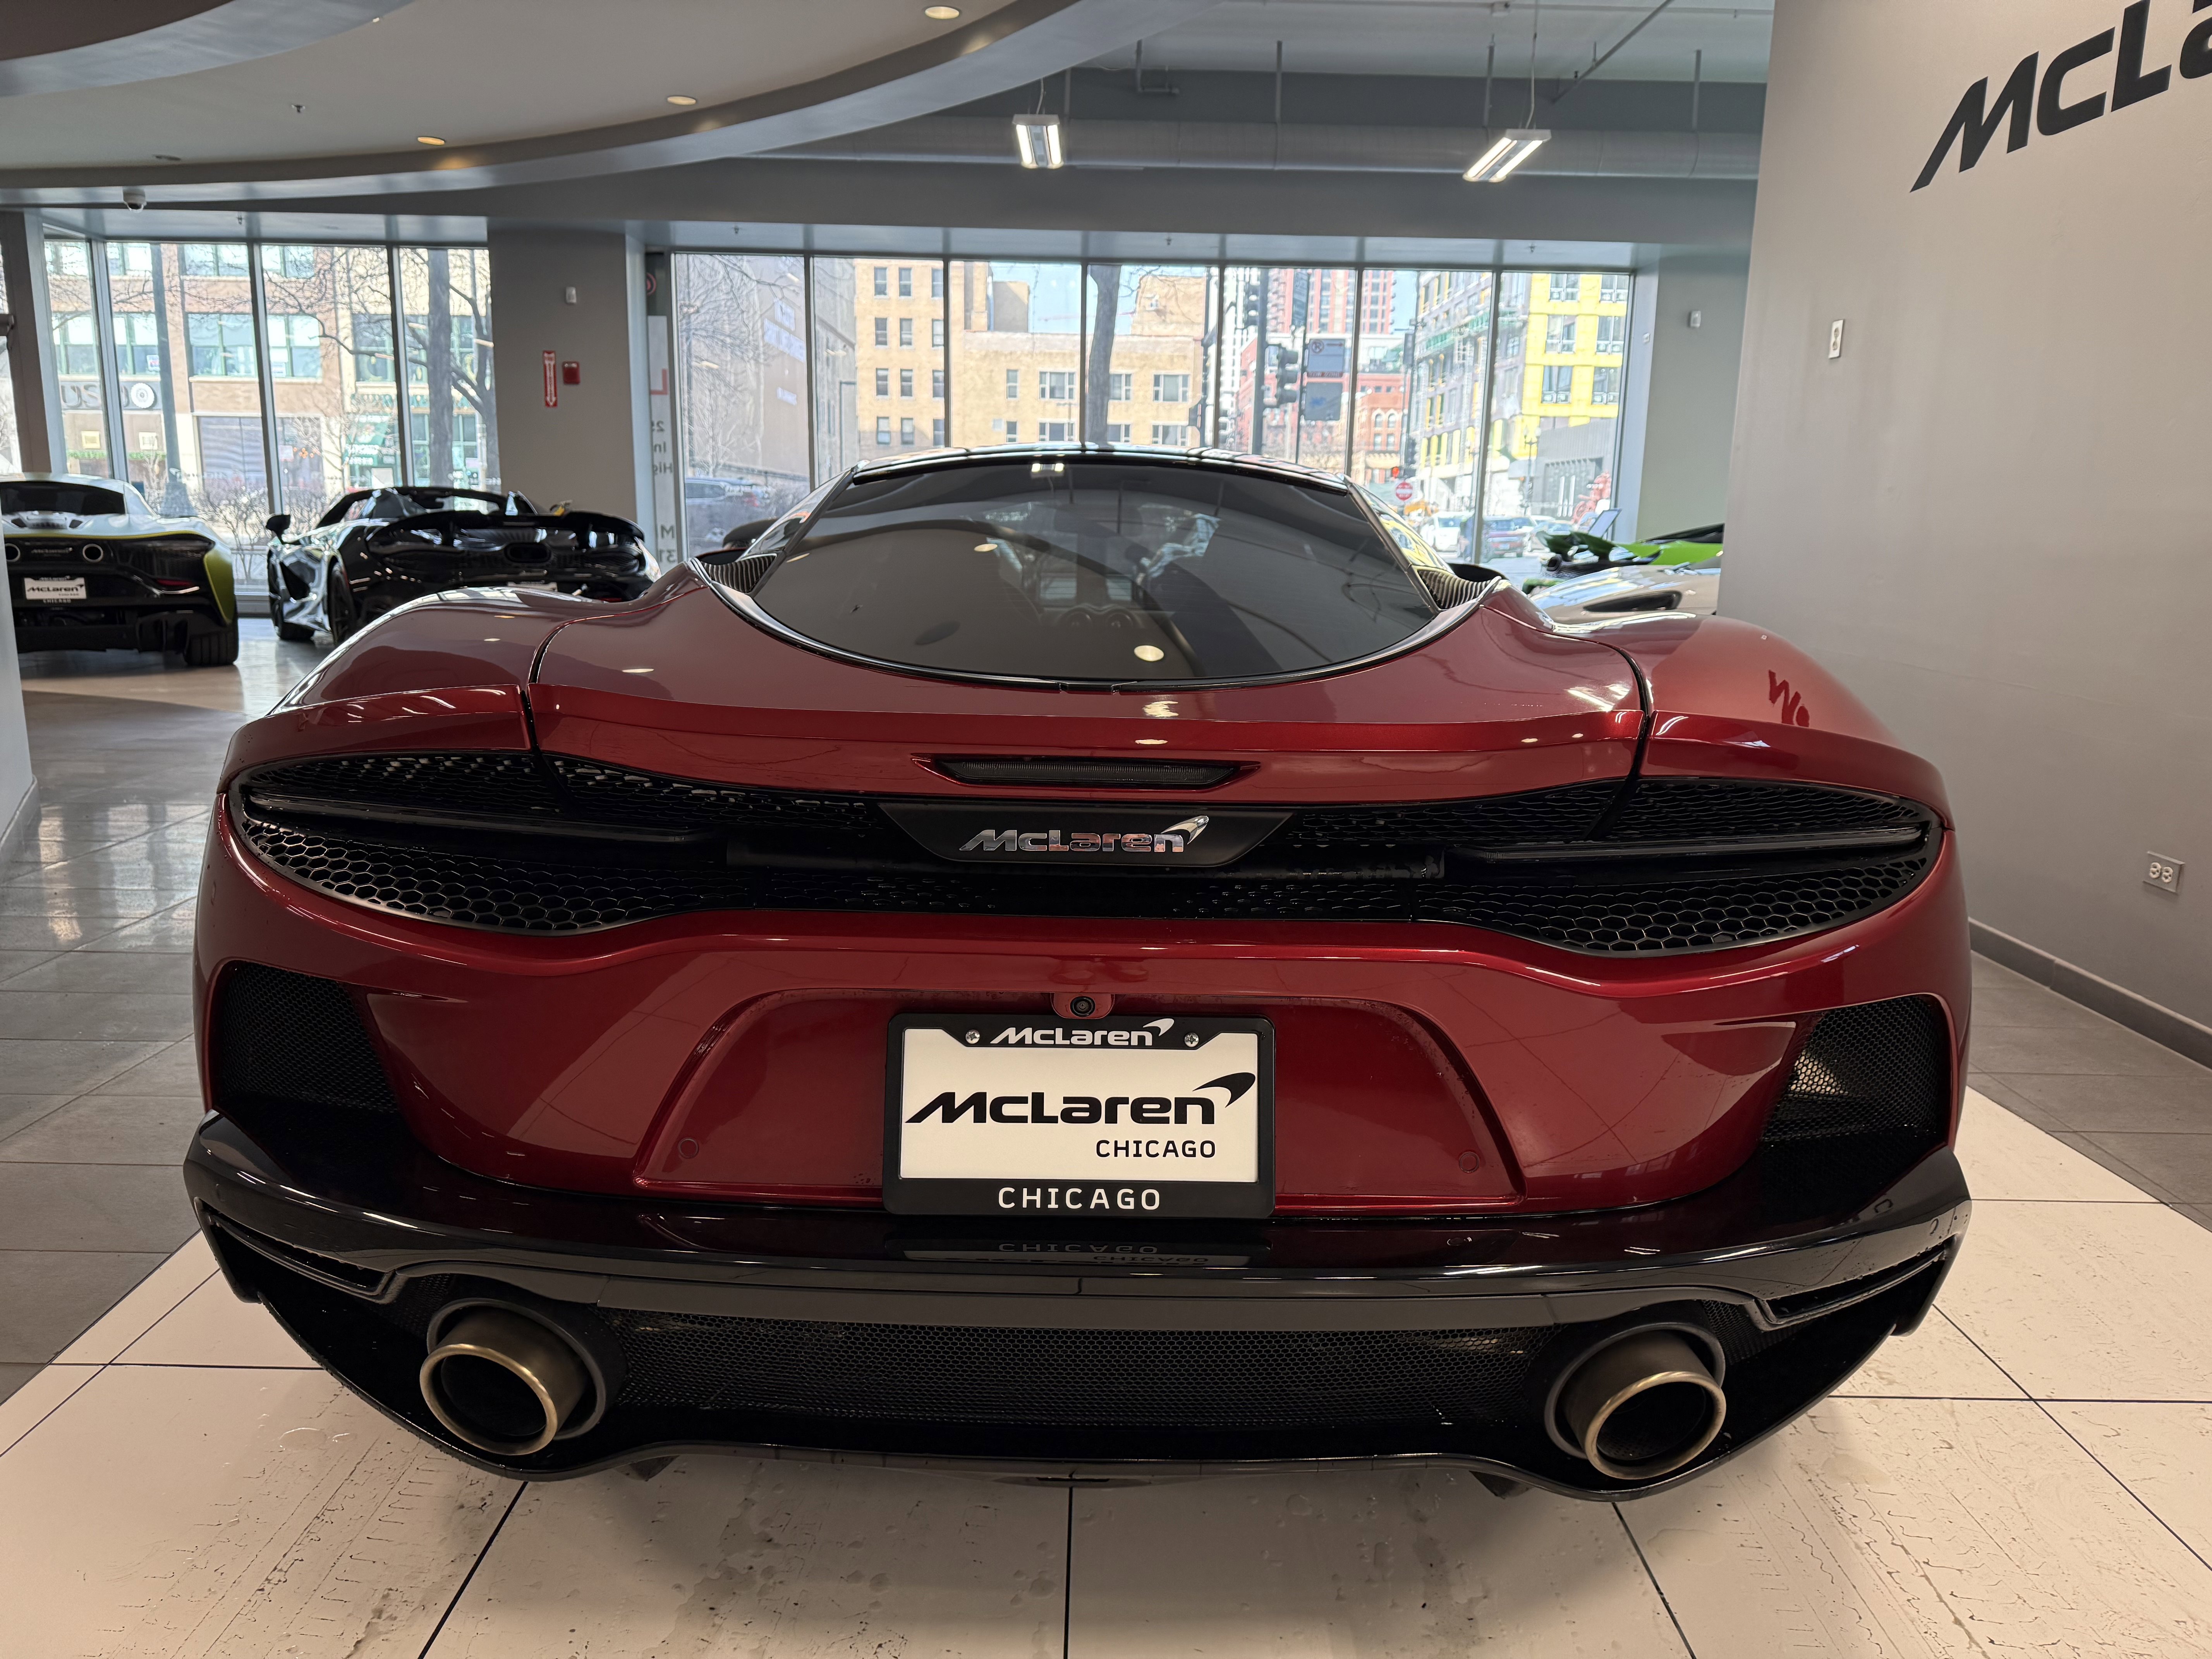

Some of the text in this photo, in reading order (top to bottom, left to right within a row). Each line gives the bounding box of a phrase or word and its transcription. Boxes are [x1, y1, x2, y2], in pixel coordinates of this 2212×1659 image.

[959, 829, 1184, 852] McLaren
[989, 1027, 1153, 1046] McLaren
[905, 1091, 1215, 1125] McLaren
[1096, 1139, 1216, 1158] CHICAGO
[998, 1187, 1160, 1211] CHICAGO
